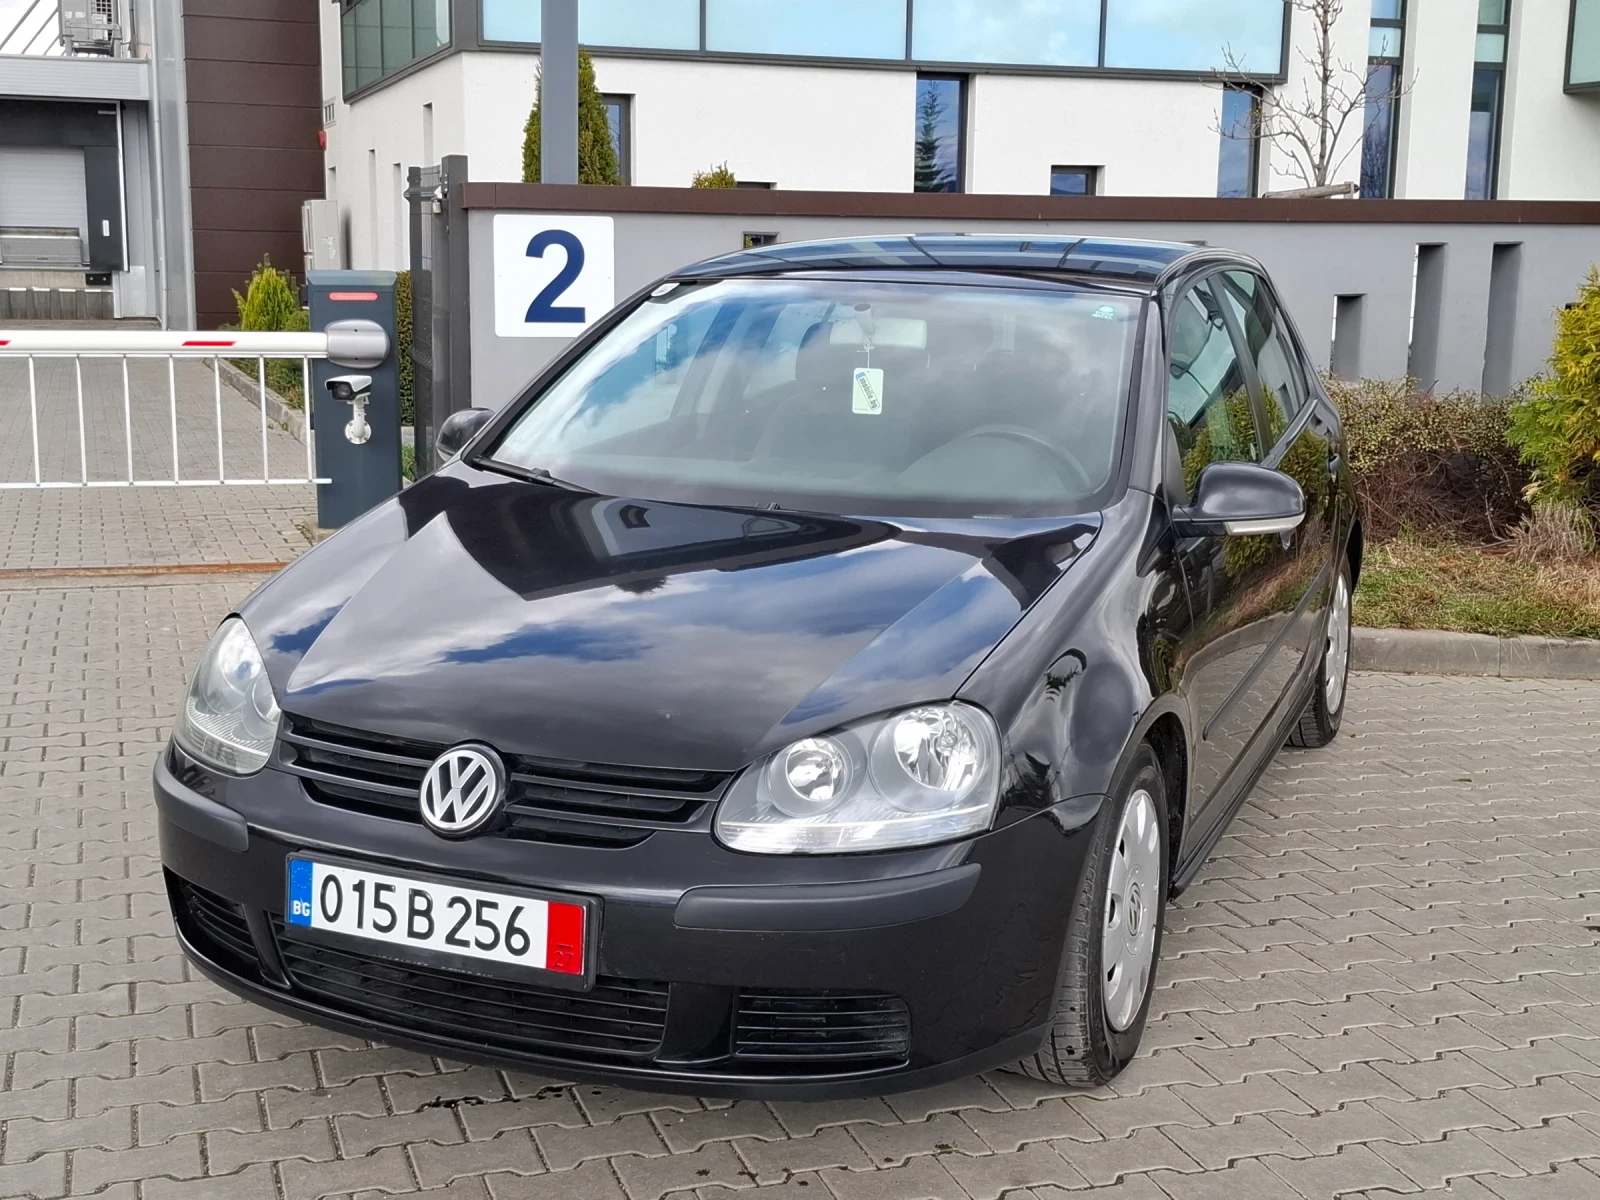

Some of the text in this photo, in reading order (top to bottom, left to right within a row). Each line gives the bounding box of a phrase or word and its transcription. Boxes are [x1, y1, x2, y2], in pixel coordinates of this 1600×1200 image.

[524, 229, 586, 323] 2
[421, 750, 496, 829] VW
[293, 900, 311, 917] BG
[554, 950, 575, 968] 27
